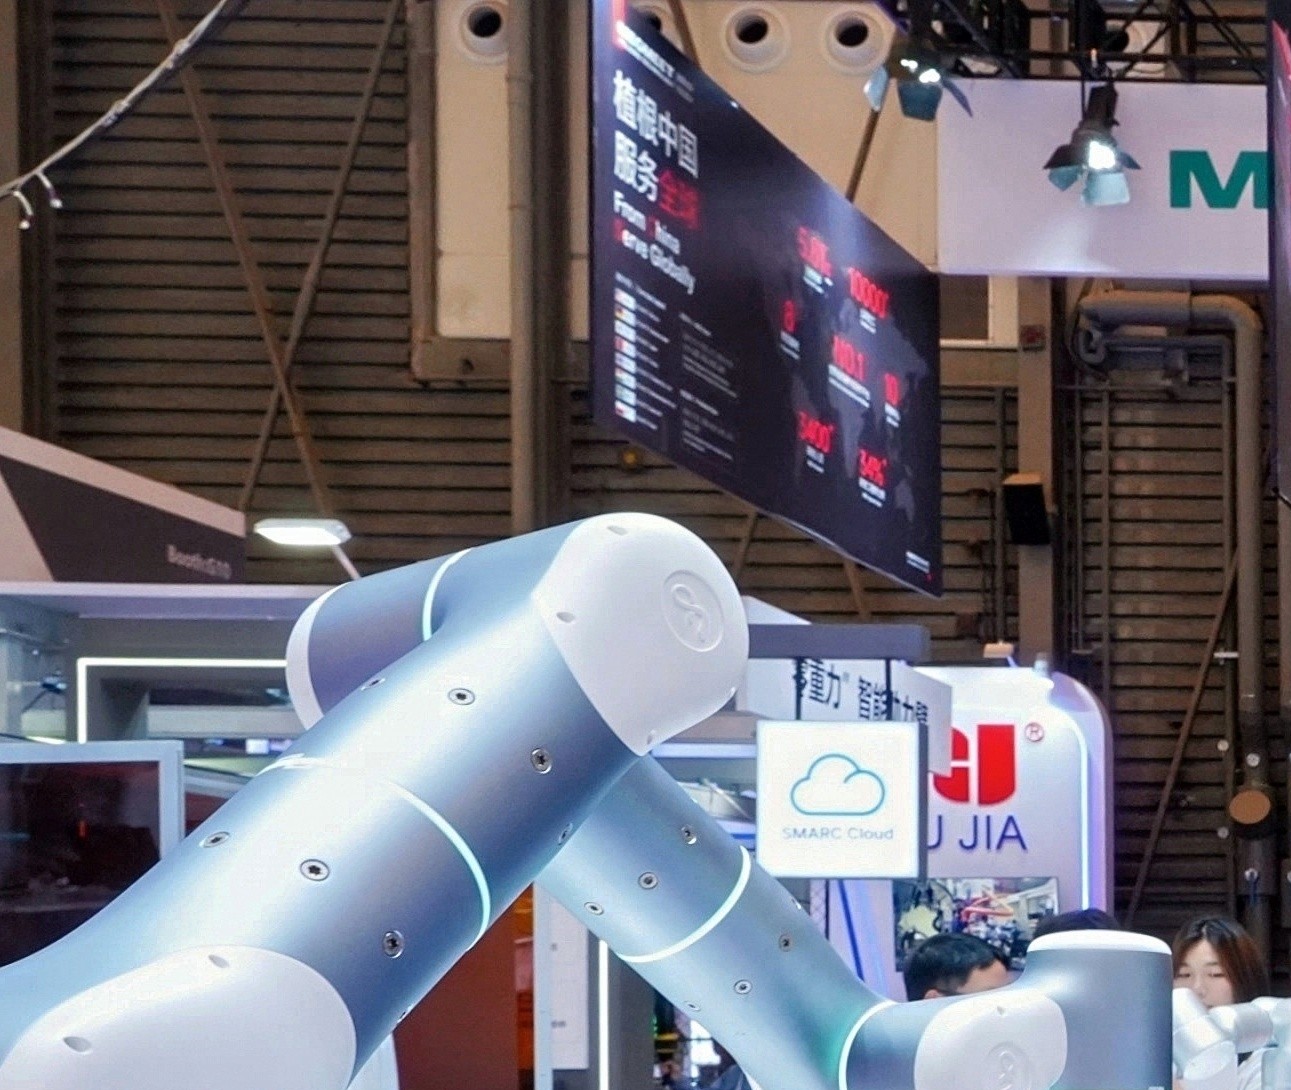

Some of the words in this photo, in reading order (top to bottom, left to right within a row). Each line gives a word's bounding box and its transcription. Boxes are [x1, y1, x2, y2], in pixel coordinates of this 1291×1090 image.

[782, 827, 842, 840] SMARC
[847, 827, 894, 840] Cloud
[959, 815, 1028, 850] JIA
